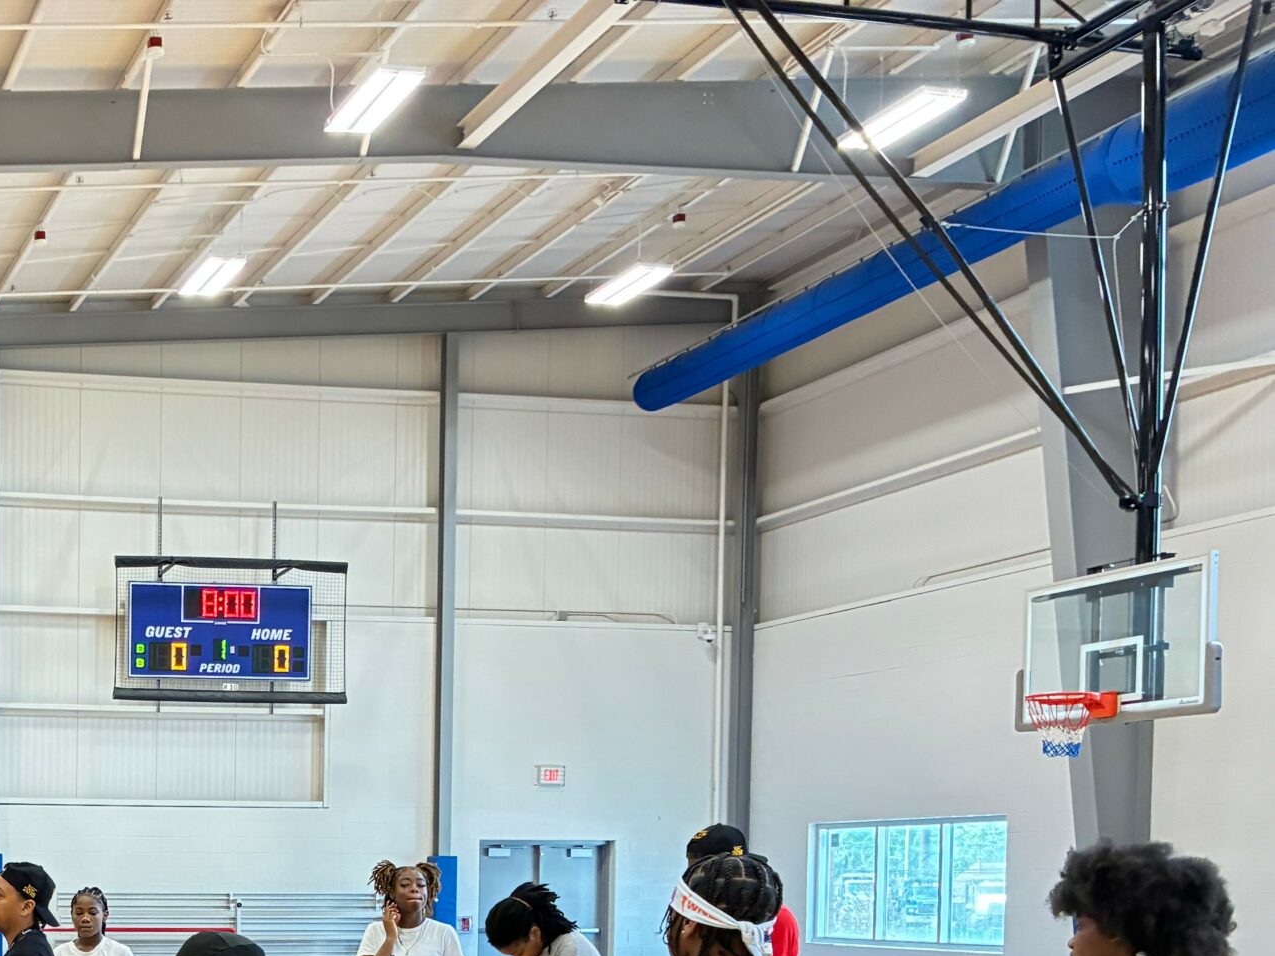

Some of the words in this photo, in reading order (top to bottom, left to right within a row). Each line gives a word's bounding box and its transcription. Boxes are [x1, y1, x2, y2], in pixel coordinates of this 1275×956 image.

[201, 589, 256, 618] 8:00
[145, 625, 192, 638] GUEST
[251, 628, 293, 641] HOME
[170, 642, 187, 671] 0
[274, 644, 290, 672] 0
[199, 662, 241, 674] PERIOD
[544, 769, 559, 781] EXIT
